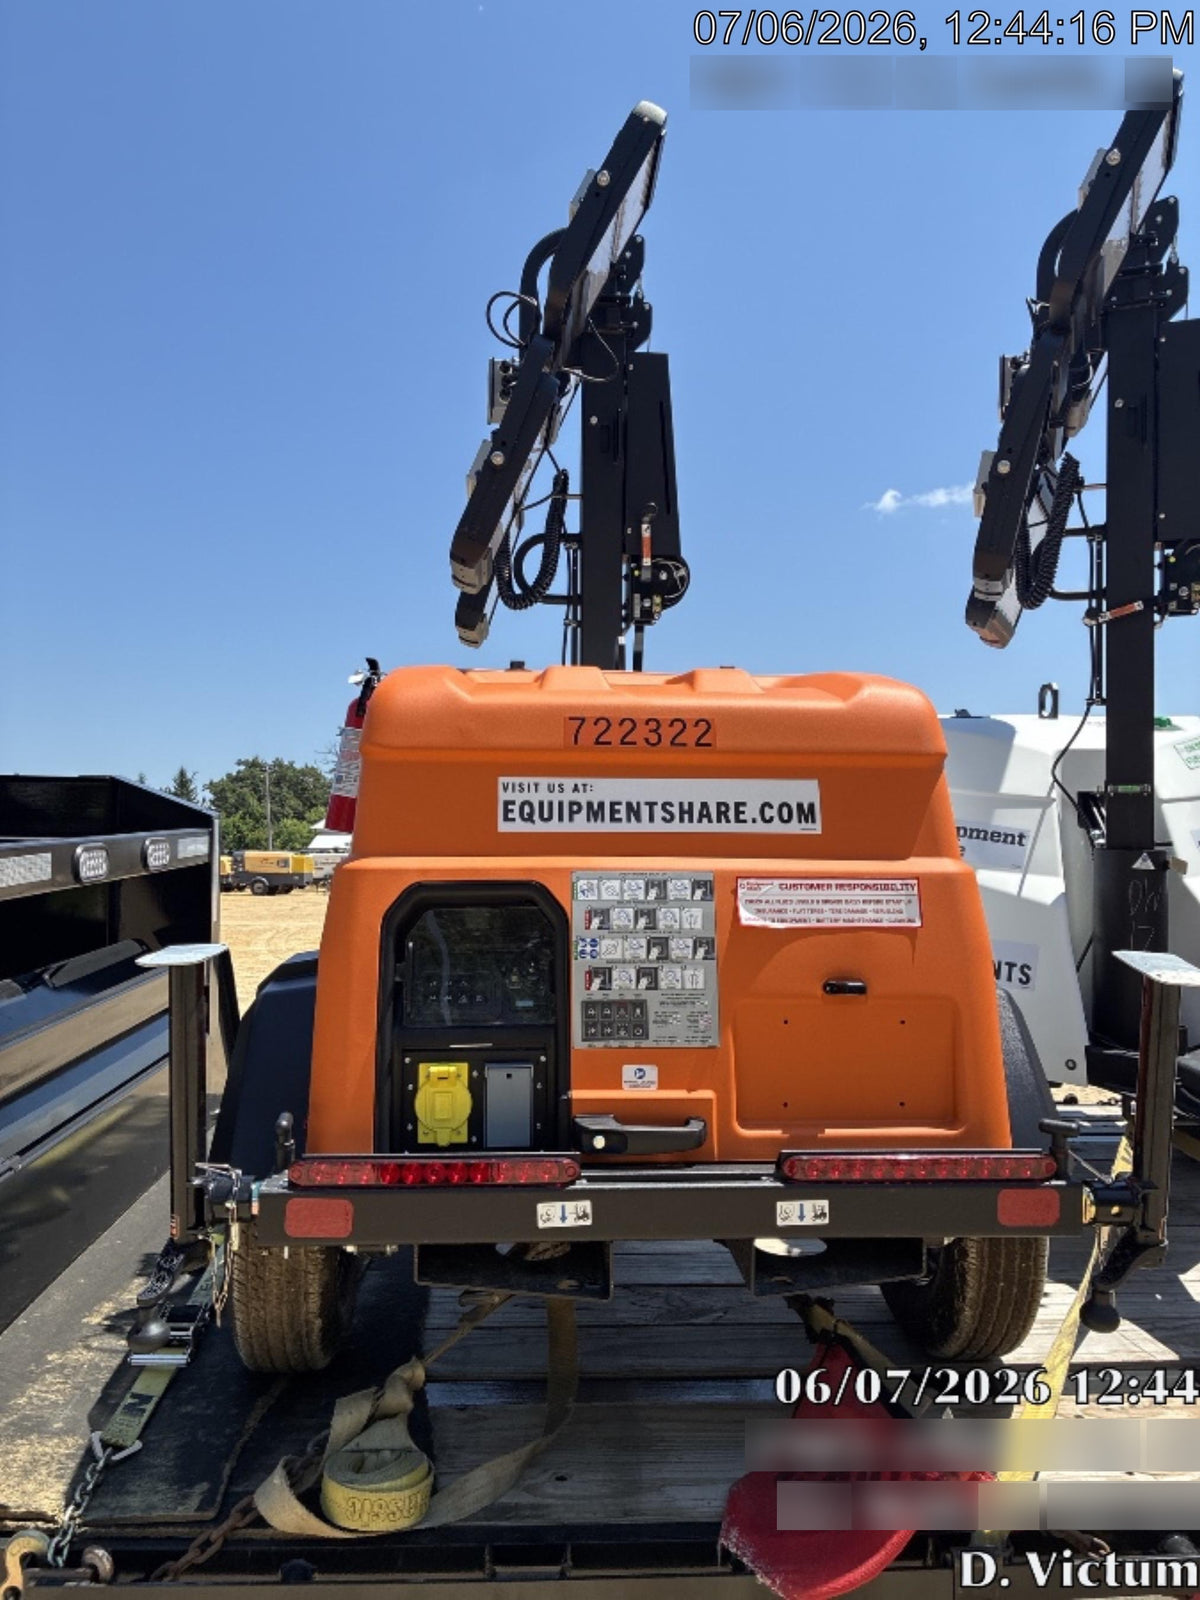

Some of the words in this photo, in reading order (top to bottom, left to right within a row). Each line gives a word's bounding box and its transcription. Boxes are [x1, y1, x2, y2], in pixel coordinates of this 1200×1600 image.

[568, 716, 713, 747] 722322
[502, 782, 540, 794] VISIT
[547, 783, 565, 794] US
[572, 783, 594, 794] AT:
[502, 800, 817, 825] EQUIPMENTSHARE.COM
[778, 882, 833, 892] CUSTOMER
[835, 882, 916, 892] RESPONSIBILITY
